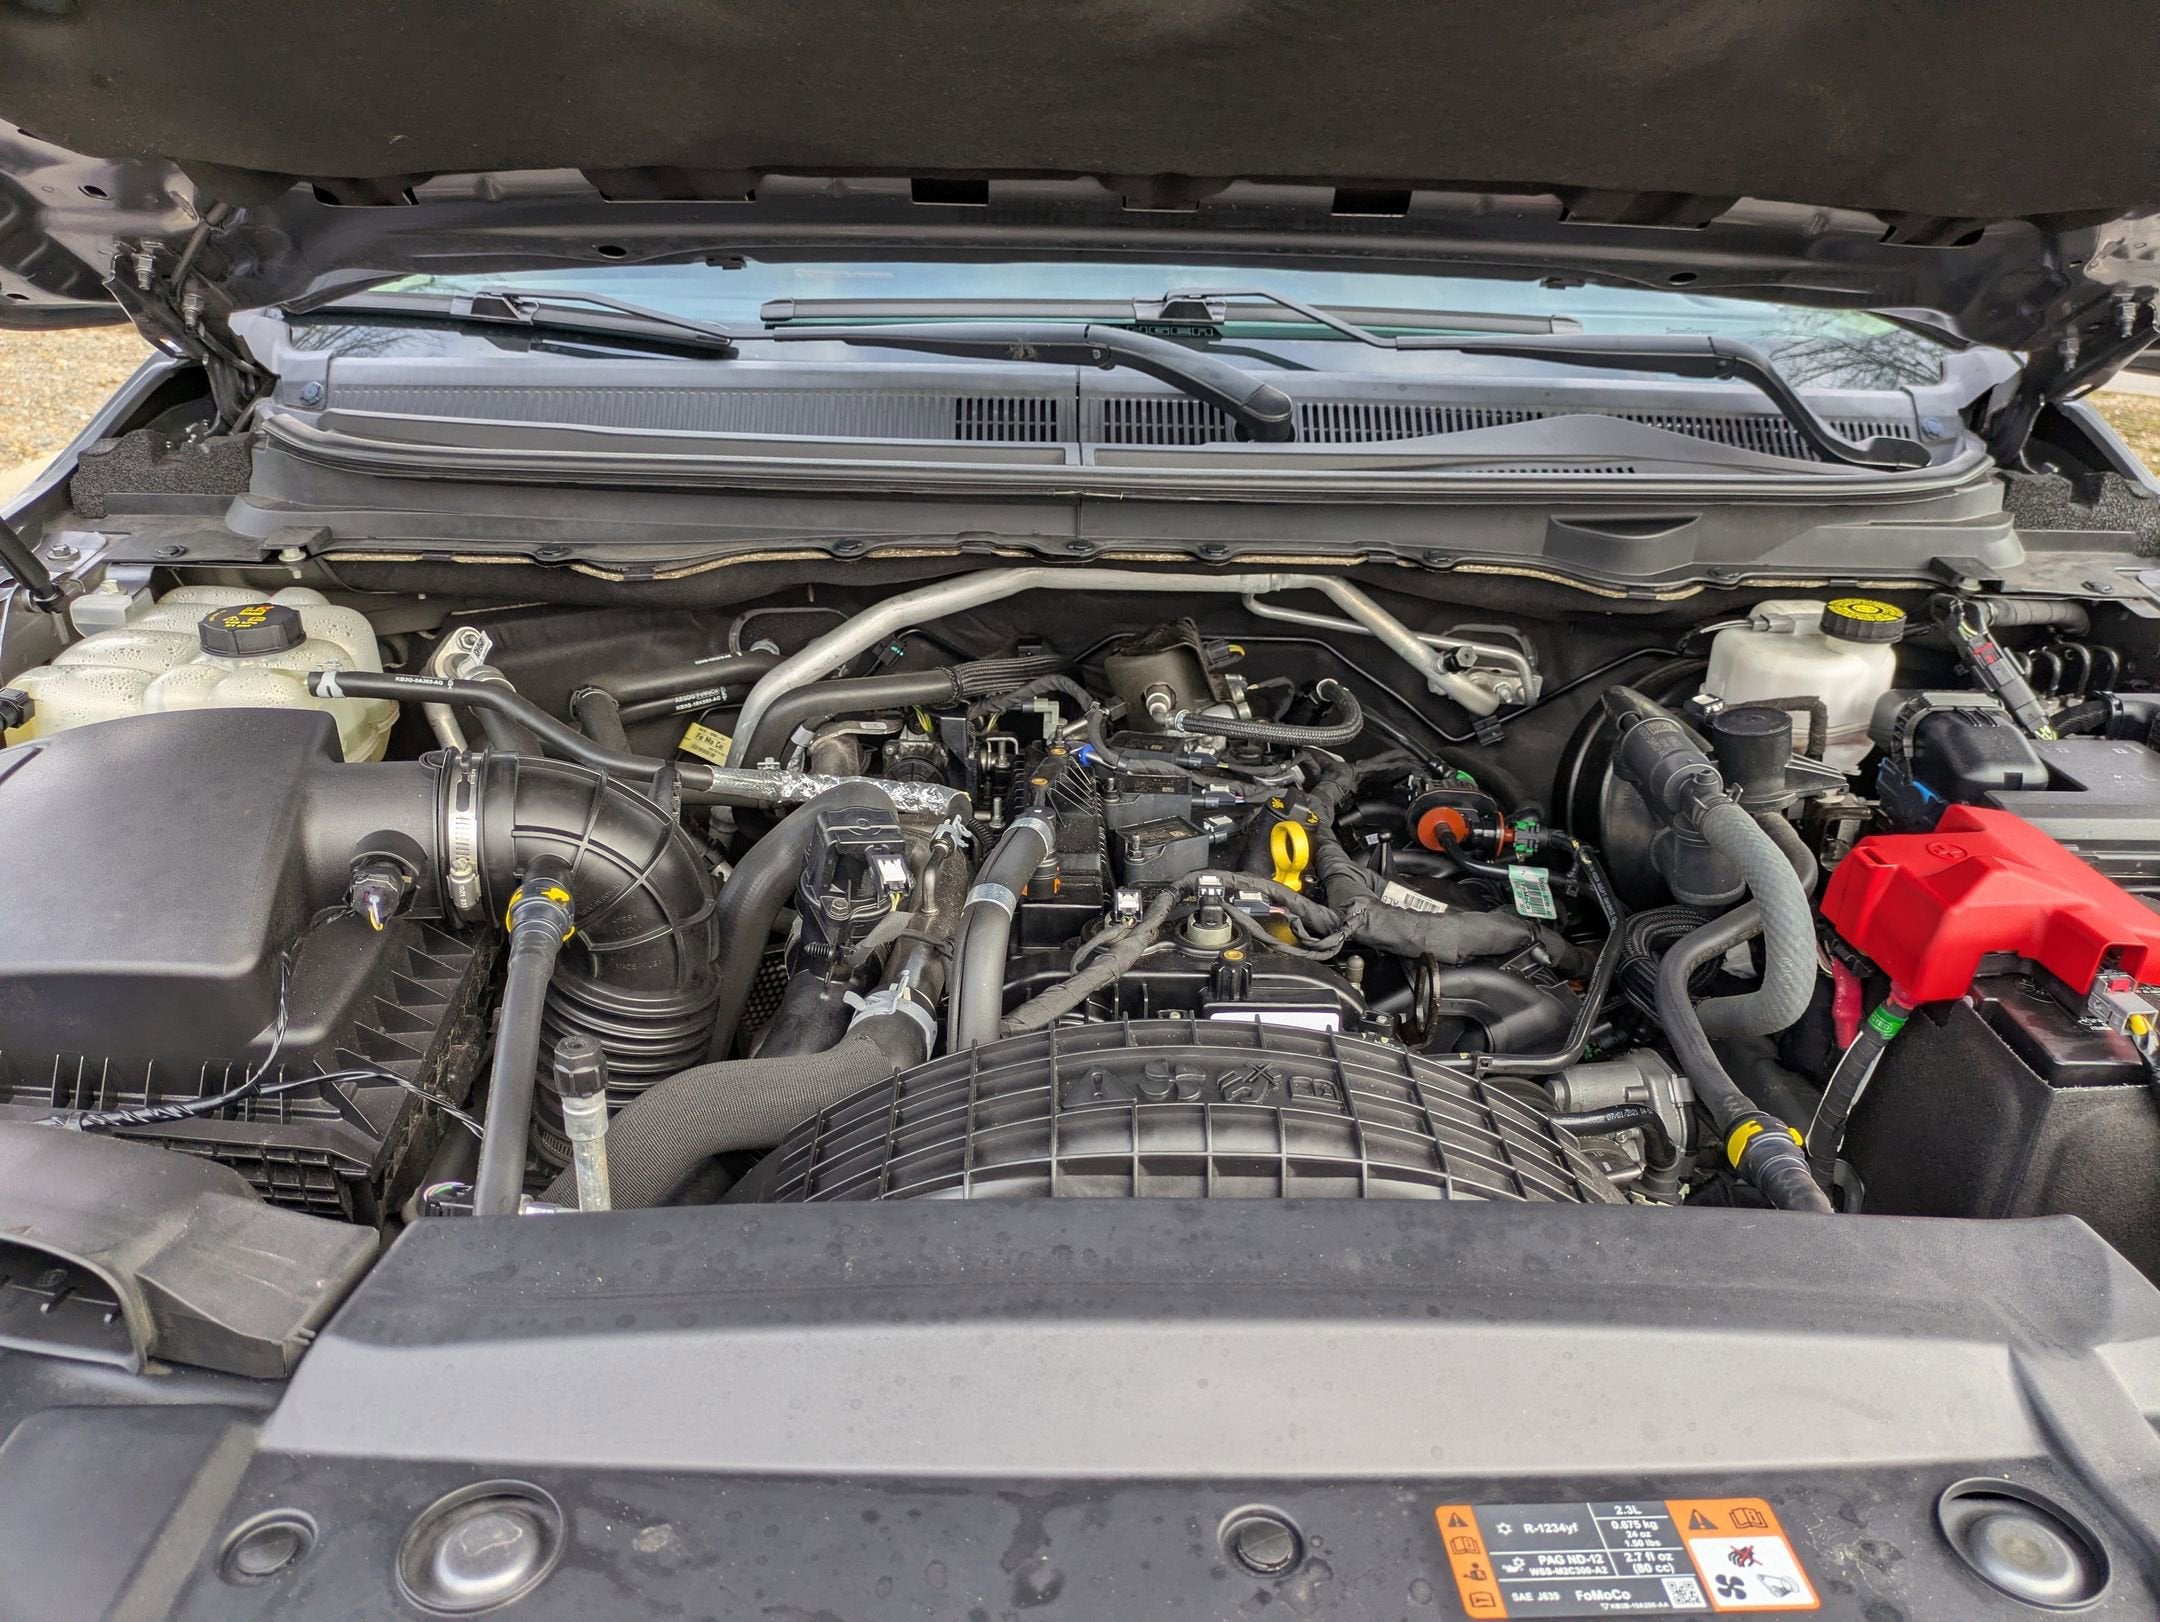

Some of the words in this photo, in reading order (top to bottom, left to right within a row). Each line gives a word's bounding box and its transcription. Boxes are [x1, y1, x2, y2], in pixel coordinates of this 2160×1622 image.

[1614, 1505, 1643, 1516] 2.3L
[1523, 1522, 1579, 1535] R-1234yf
[1642, 1520, 1659, 1531] kg
[1645, 1539, 1662, 1547] lbs
[1538, 1555, 1566, 1566] PAG
[1567, 1554, 1605, 1565] ND-12
[1623, 1551, 1643, 1563] 2.7
[1657, 1553, 1675, 1562] oz
[1655, 1562, 1676, 1575] cc)
[1511, 1592, 1534, 1602] SAE
[1574, 1589, 1632, 1602] FoMoCo
